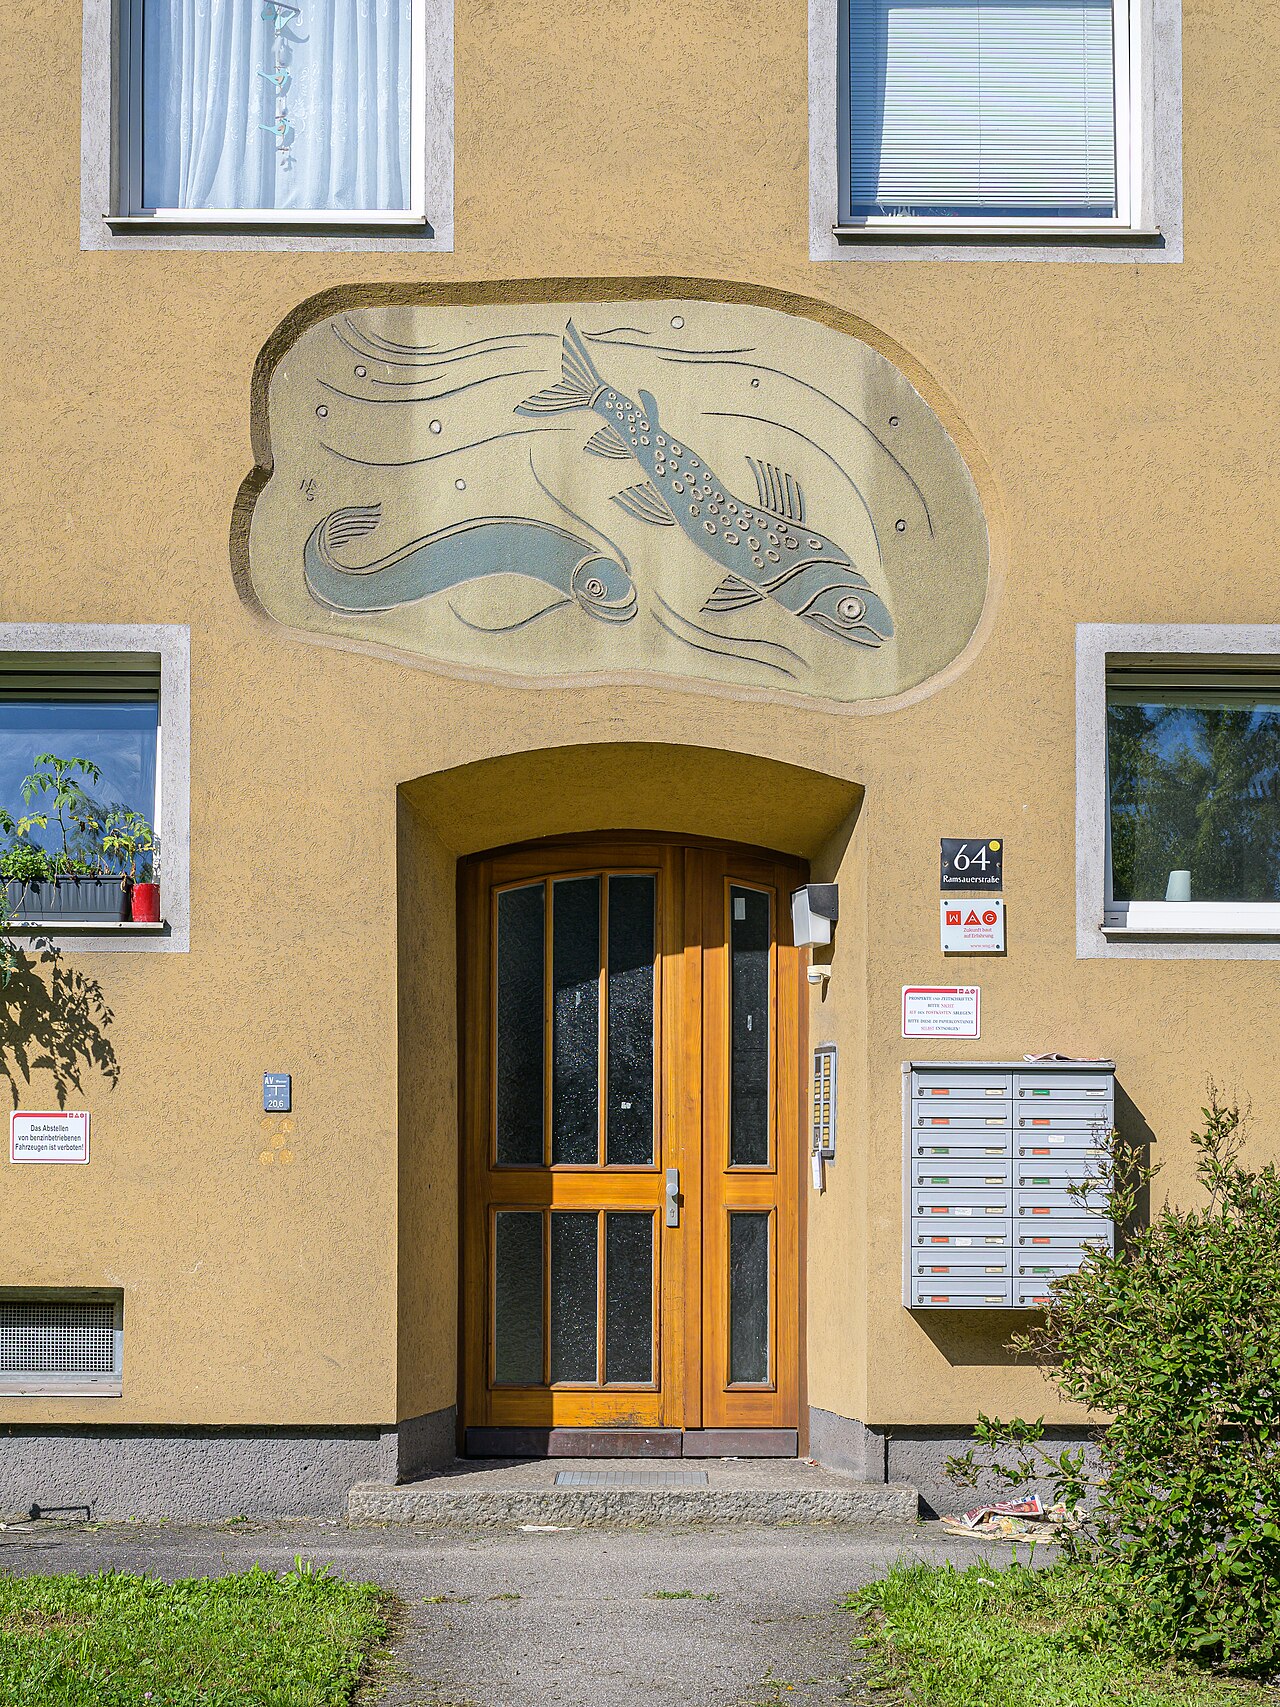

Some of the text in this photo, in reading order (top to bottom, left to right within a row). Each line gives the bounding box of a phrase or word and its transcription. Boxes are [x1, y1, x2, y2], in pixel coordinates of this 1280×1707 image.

[954, 844, 990, 870] 64
[943, 874, 1000, 884] Ramsauerstraße
[947, 910, 997, 925] WAG
[268, 1100, 284, 1108] 20,6
[15, 1143, 48, 1152] Fahrzeugen
